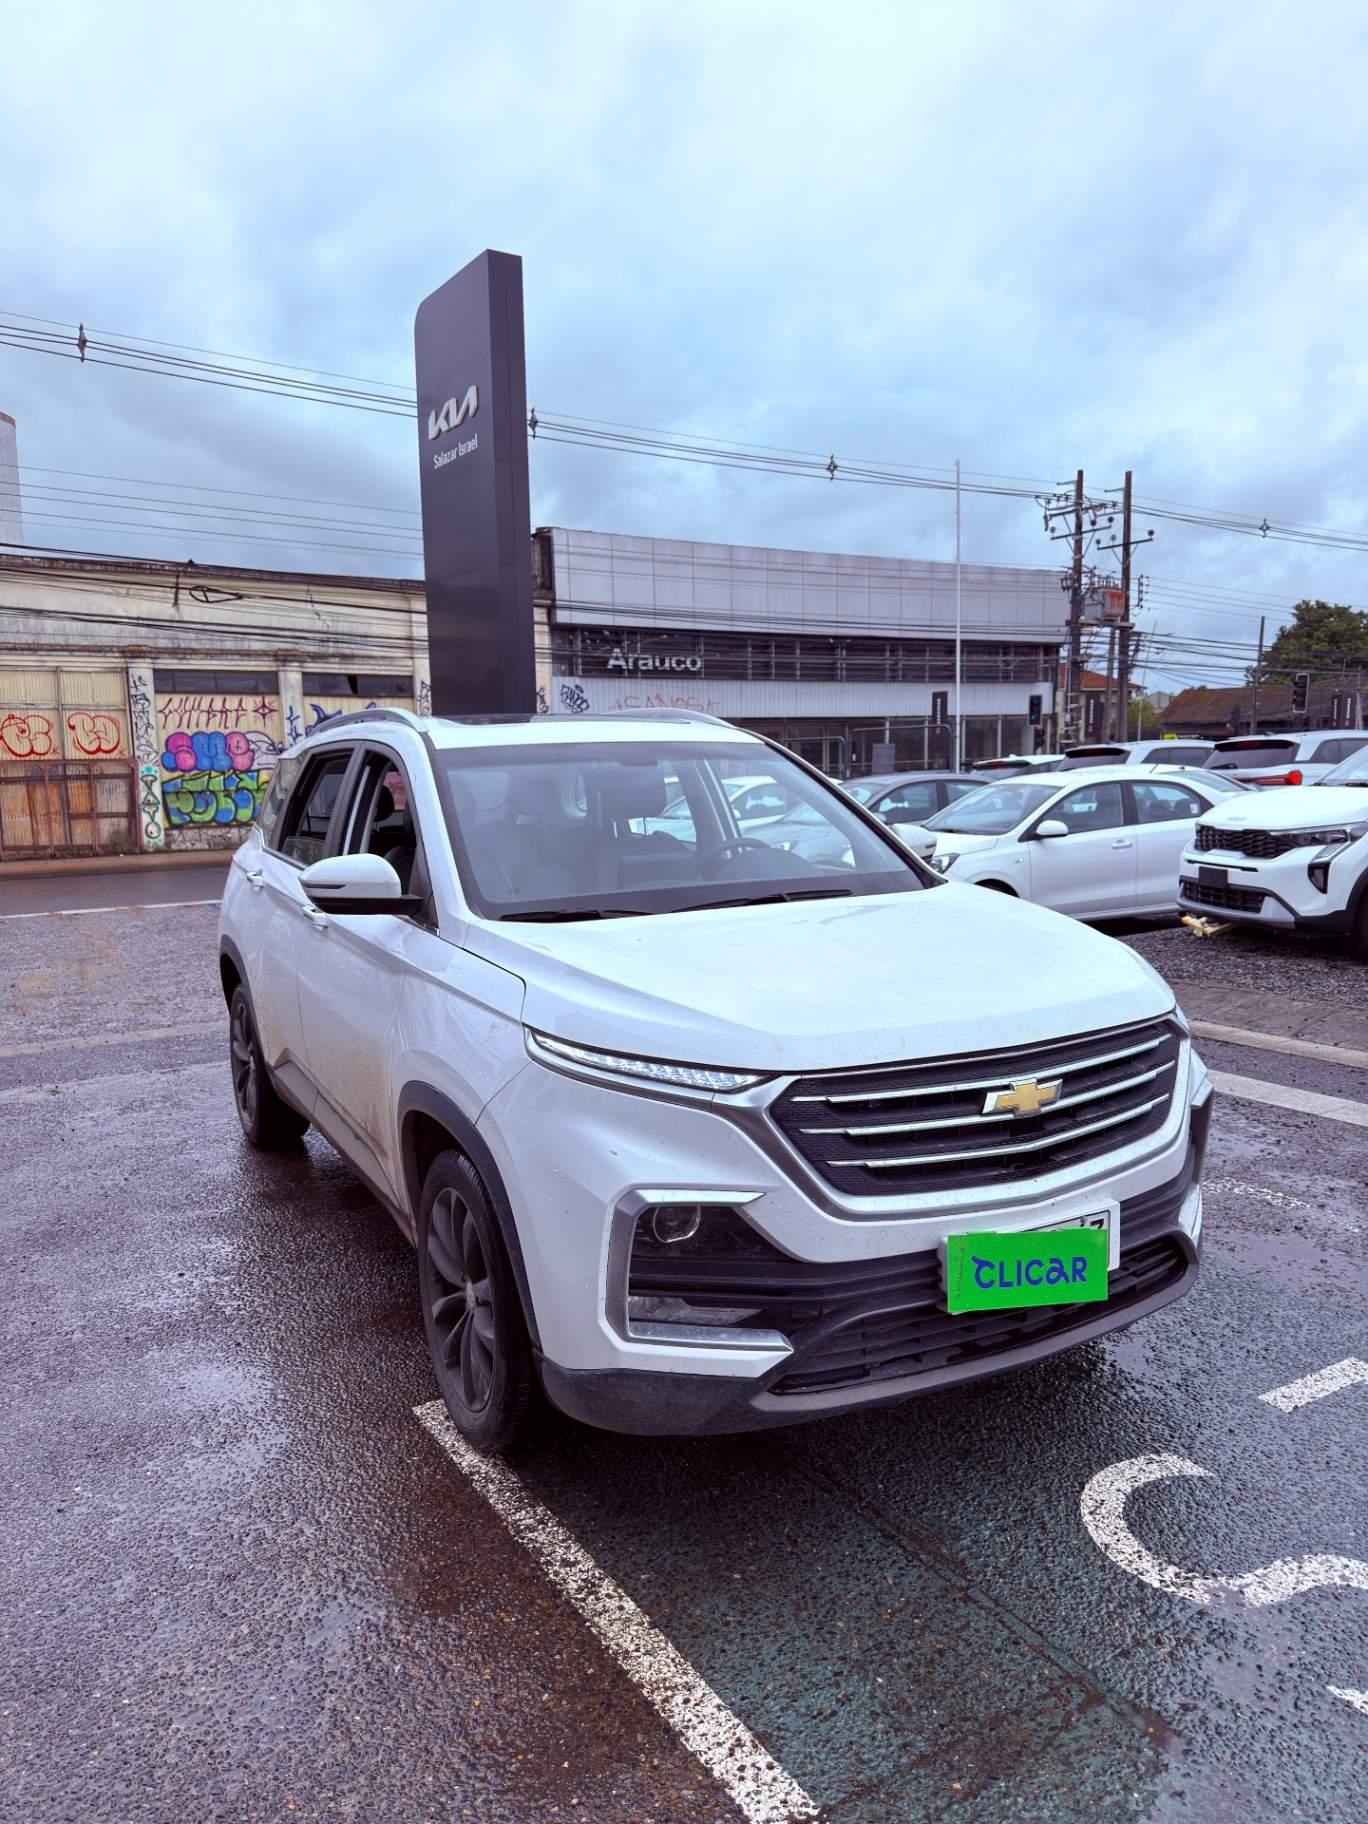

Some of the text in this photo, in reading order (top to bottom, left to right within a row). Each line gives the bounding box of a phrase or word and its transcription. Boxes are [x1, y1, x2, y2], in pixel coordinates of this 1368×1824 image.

[428, 384, 478, 440] KIA
[433, 433, 478, 469] Salazar Israel
[607, 648, 701, 671] Arauco
